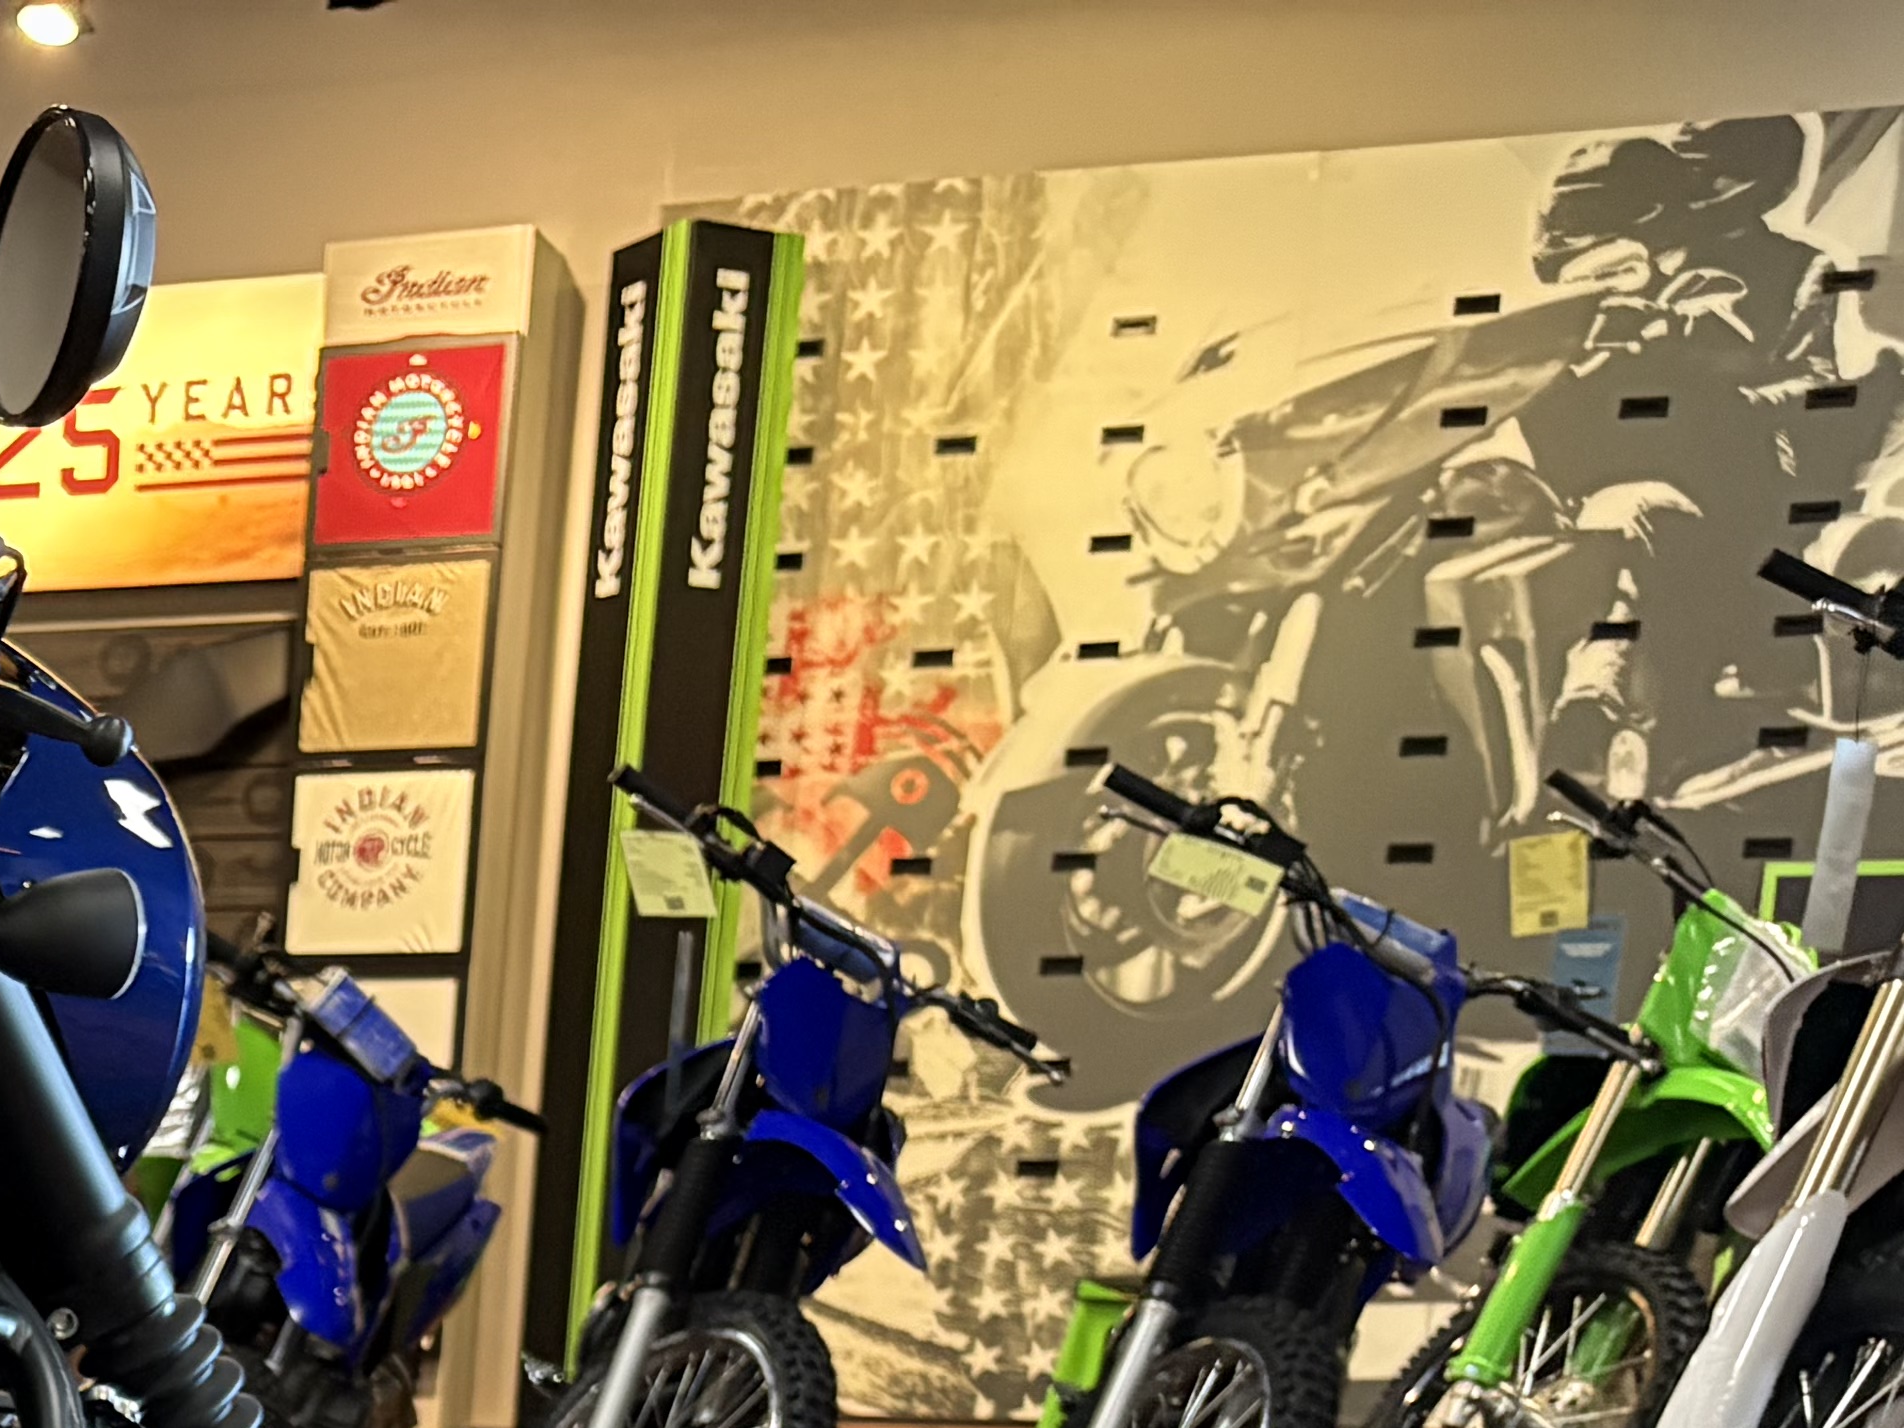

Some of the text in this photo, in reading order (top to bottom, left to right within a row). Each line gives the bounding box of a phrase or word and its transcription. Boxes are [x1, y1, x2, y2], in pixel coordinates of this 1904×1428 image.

[361, 265, 490, 305] Indian
[594, 279, 648, 599] Kawasaki
[688, 268, 750, 589] Kawasaki
[338, 581, 449, 622] INDIAN
[323, 785, 431, 834] INDIAN
